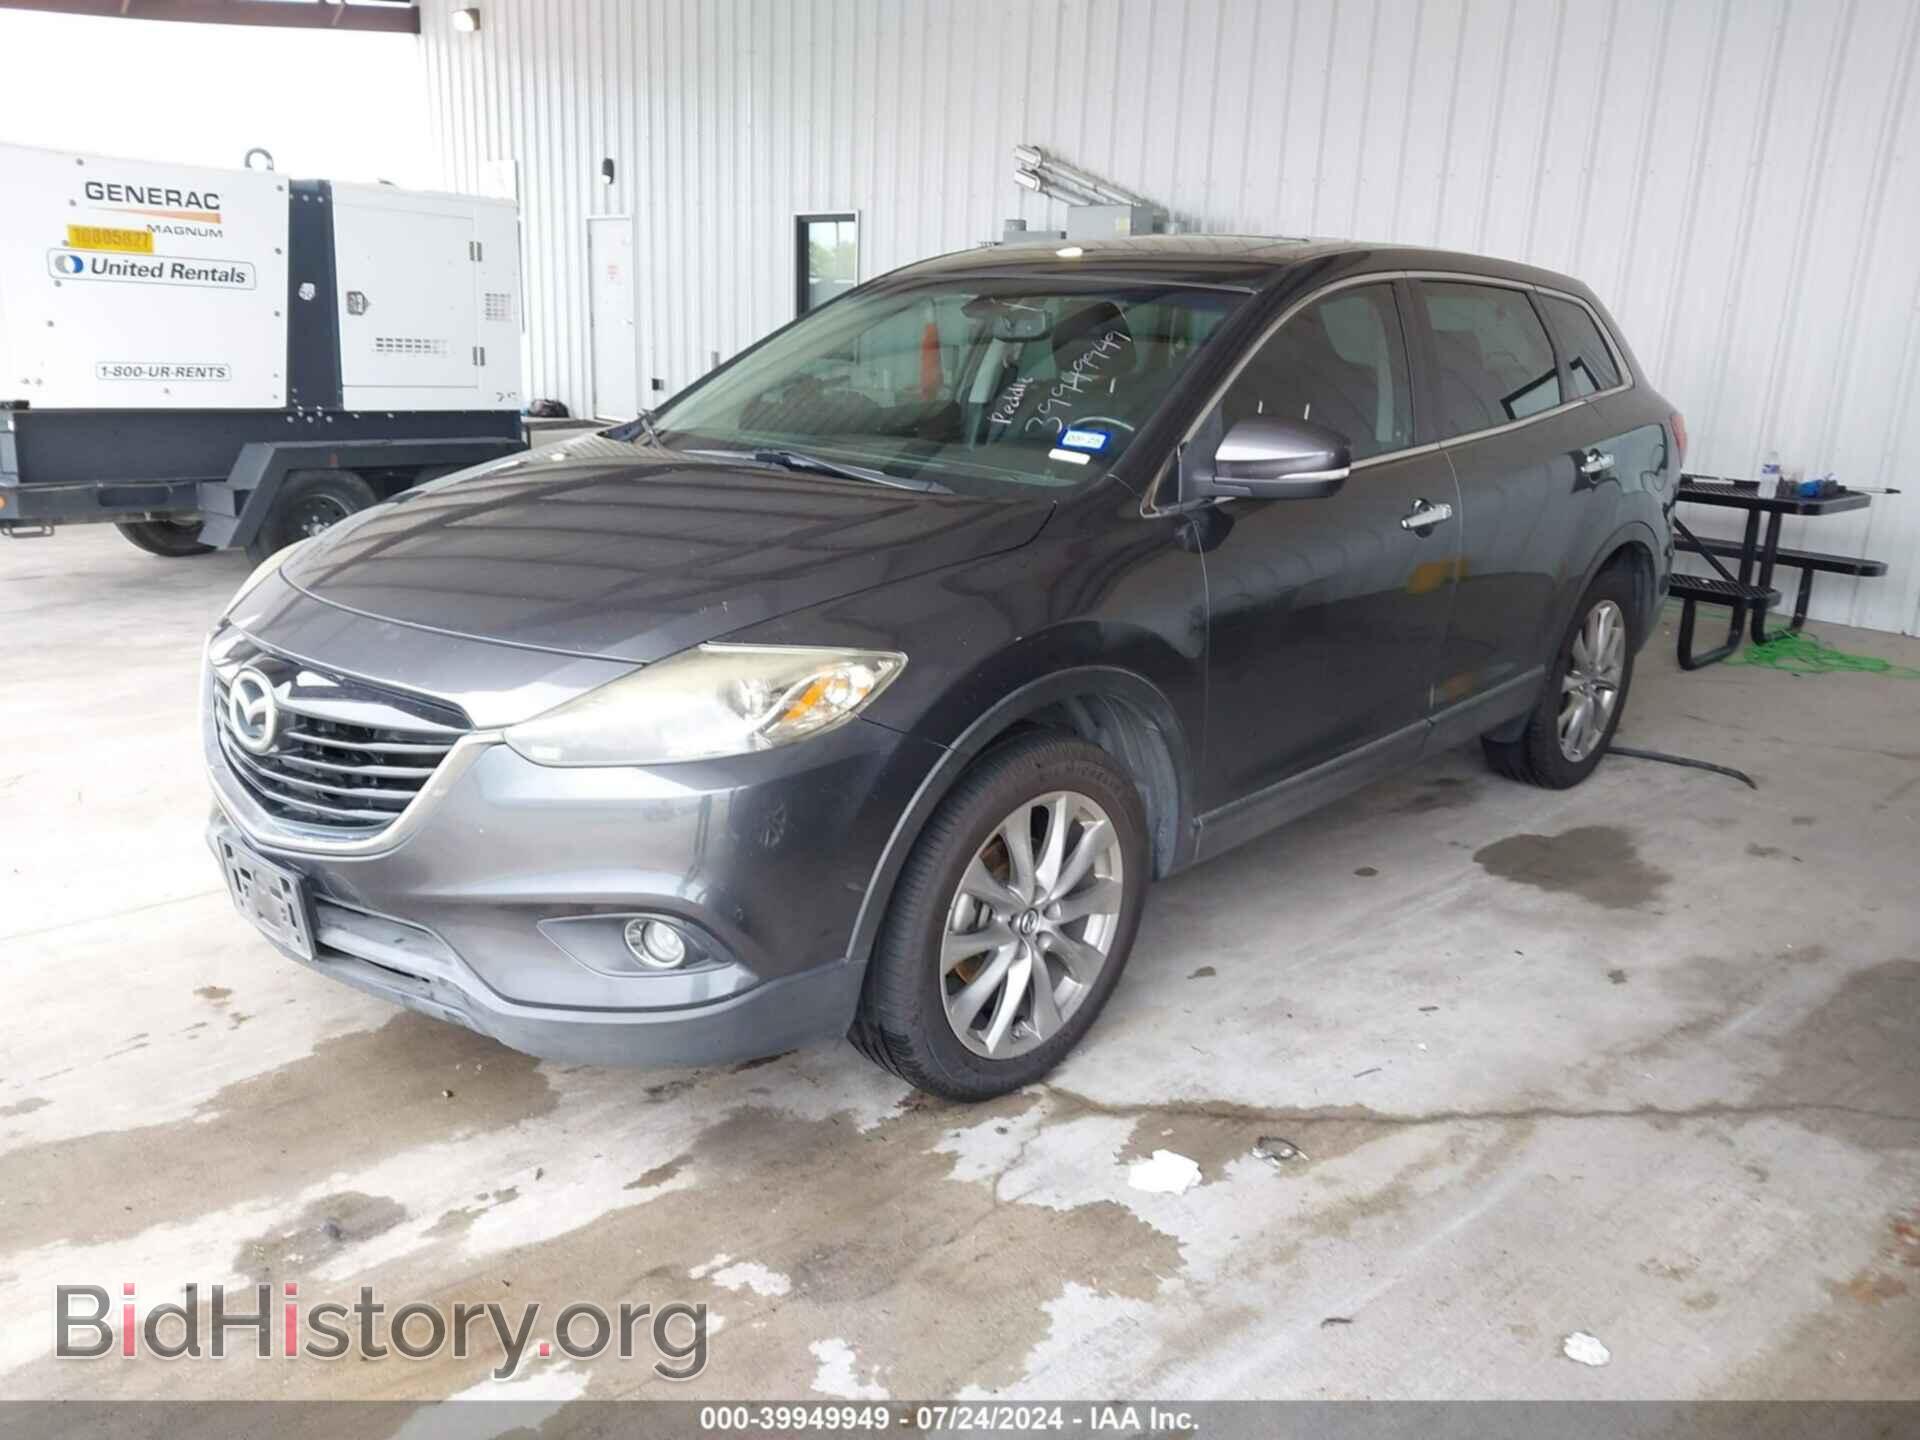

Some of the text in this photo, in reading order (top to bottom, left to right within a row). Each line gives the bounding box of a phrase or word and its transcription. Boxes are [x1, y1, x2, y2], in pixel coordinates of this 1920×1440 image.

[85, 181, 221, 210] GENERAC
[146, 224, 223, 238] MAGNUM
[91, 257, 246, 284] United Rentals
[102, 366, 225, 379] 1-800-UR-RENTS
